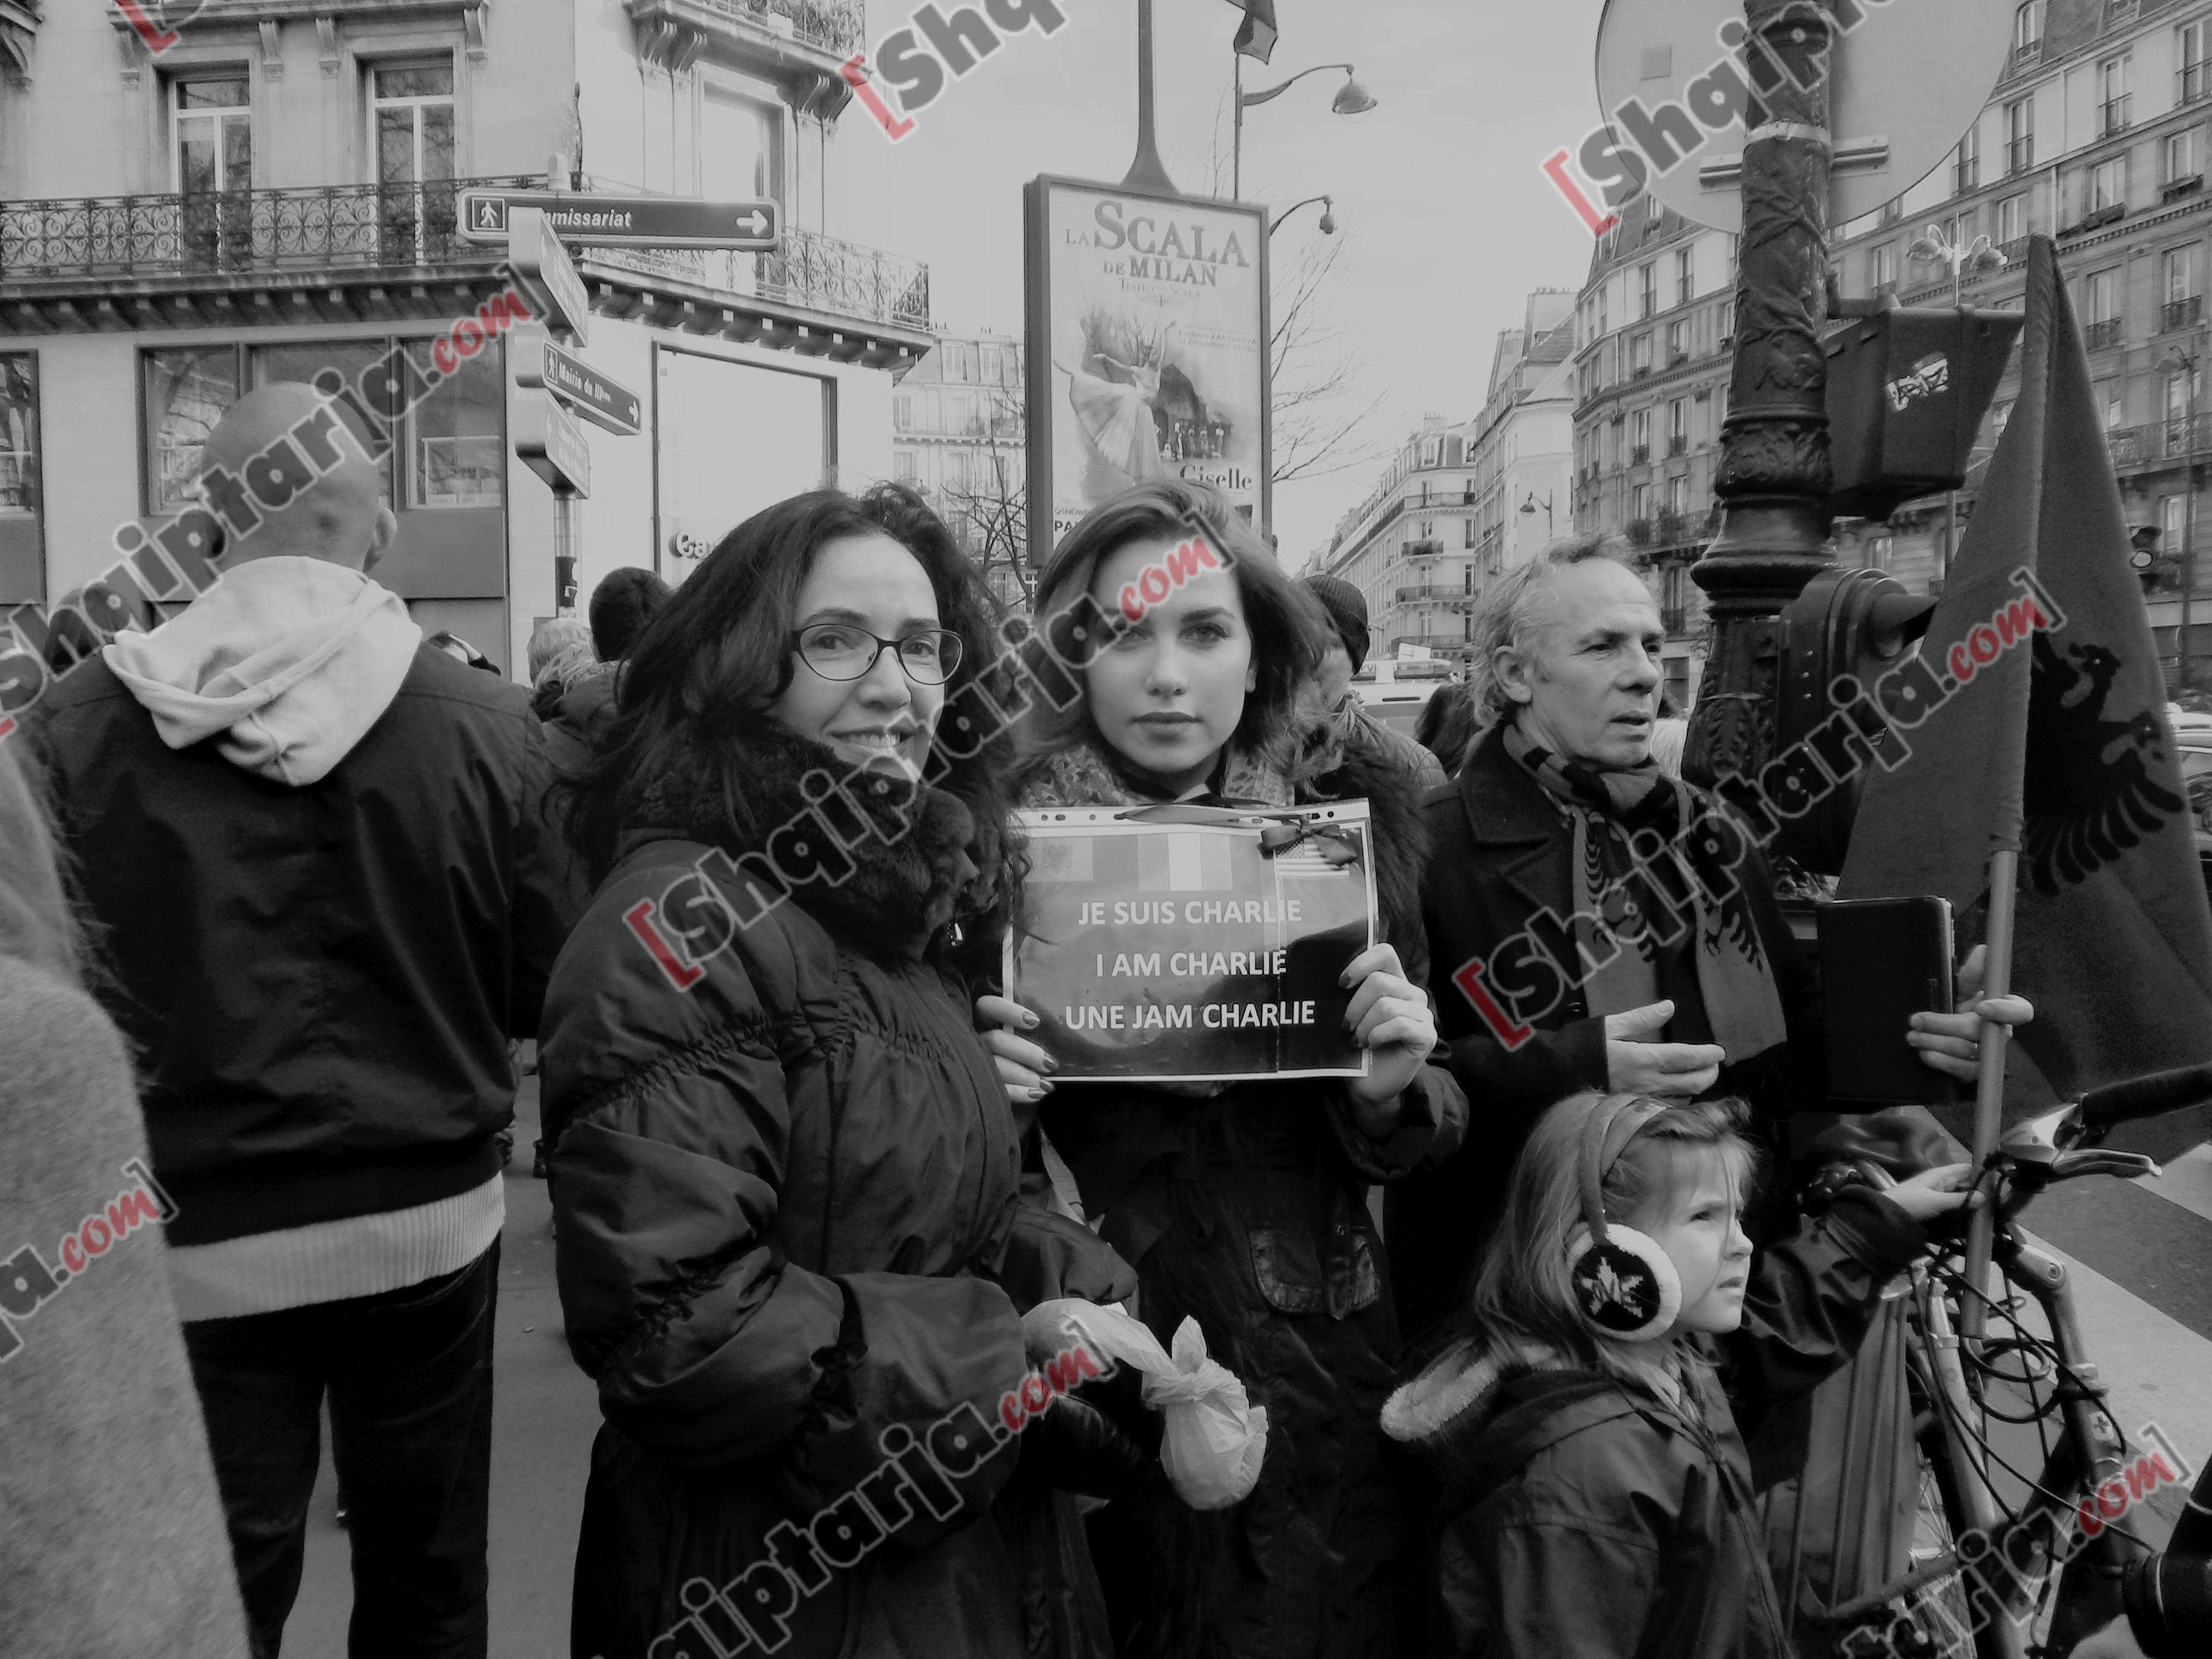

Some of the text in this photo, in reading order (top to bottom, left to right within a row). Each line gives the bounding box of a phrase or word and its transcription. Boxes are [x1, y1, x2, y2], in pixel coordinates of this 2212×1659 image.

[1065, 199, 1250, 269] LA SCALA
[1102, 254, 1218, 288] DE MILAN
[559, 361, 582, 390] Mairie
[583, 377, 593, 396] du
[1054, 520, 1078, 533] PA
[1078, 900, 1302, 925] JE SUIS CHARLIE
[1096, 950, 1287, 977] I AM CHARLIE
[1065, 1000, 1316, 1030] UNE JAM CHARLIE
